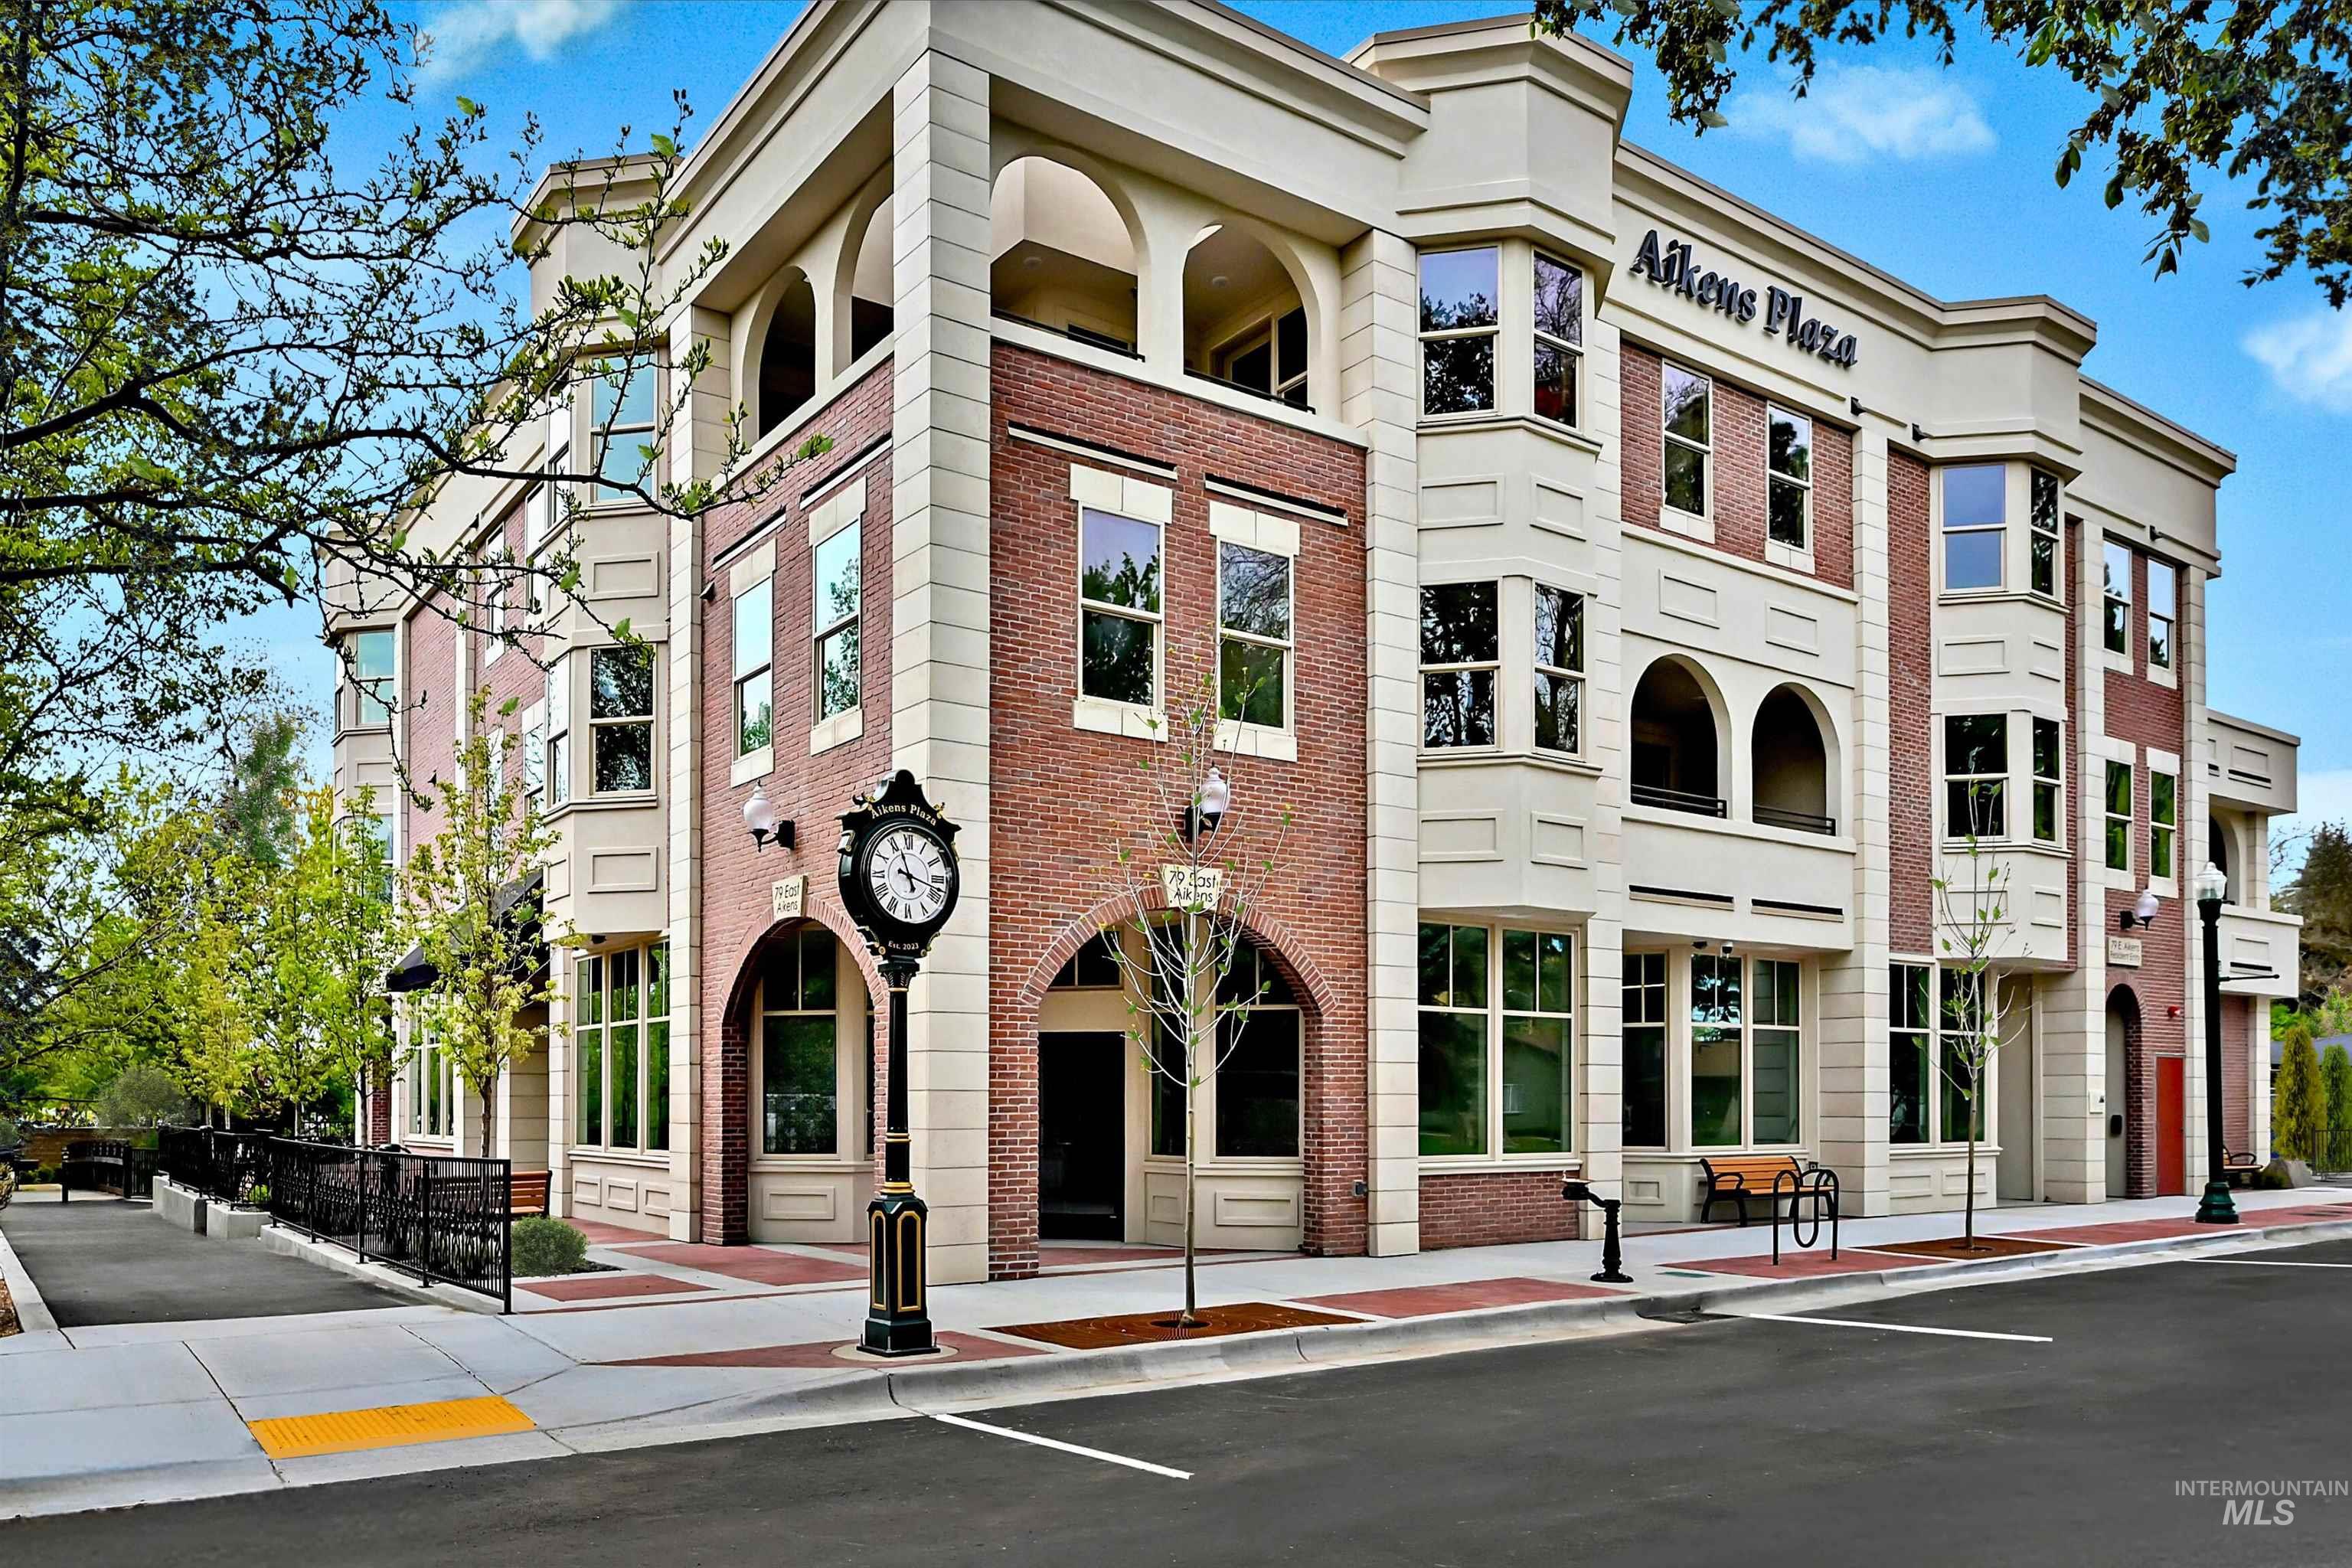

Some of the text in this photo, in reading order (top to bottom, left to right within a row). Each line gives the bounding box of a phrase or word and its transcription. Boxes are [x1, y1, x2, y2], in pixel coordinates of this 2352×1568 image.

[1629, 229, 1858, 368] Aikens Plaza
[871, 803, 937, 826] Aikens Plaza
[1169, 870, 1185, 885] 79
[775, 886, 783, 901] 79
[1174, 887, 1213, 903] Aikens
